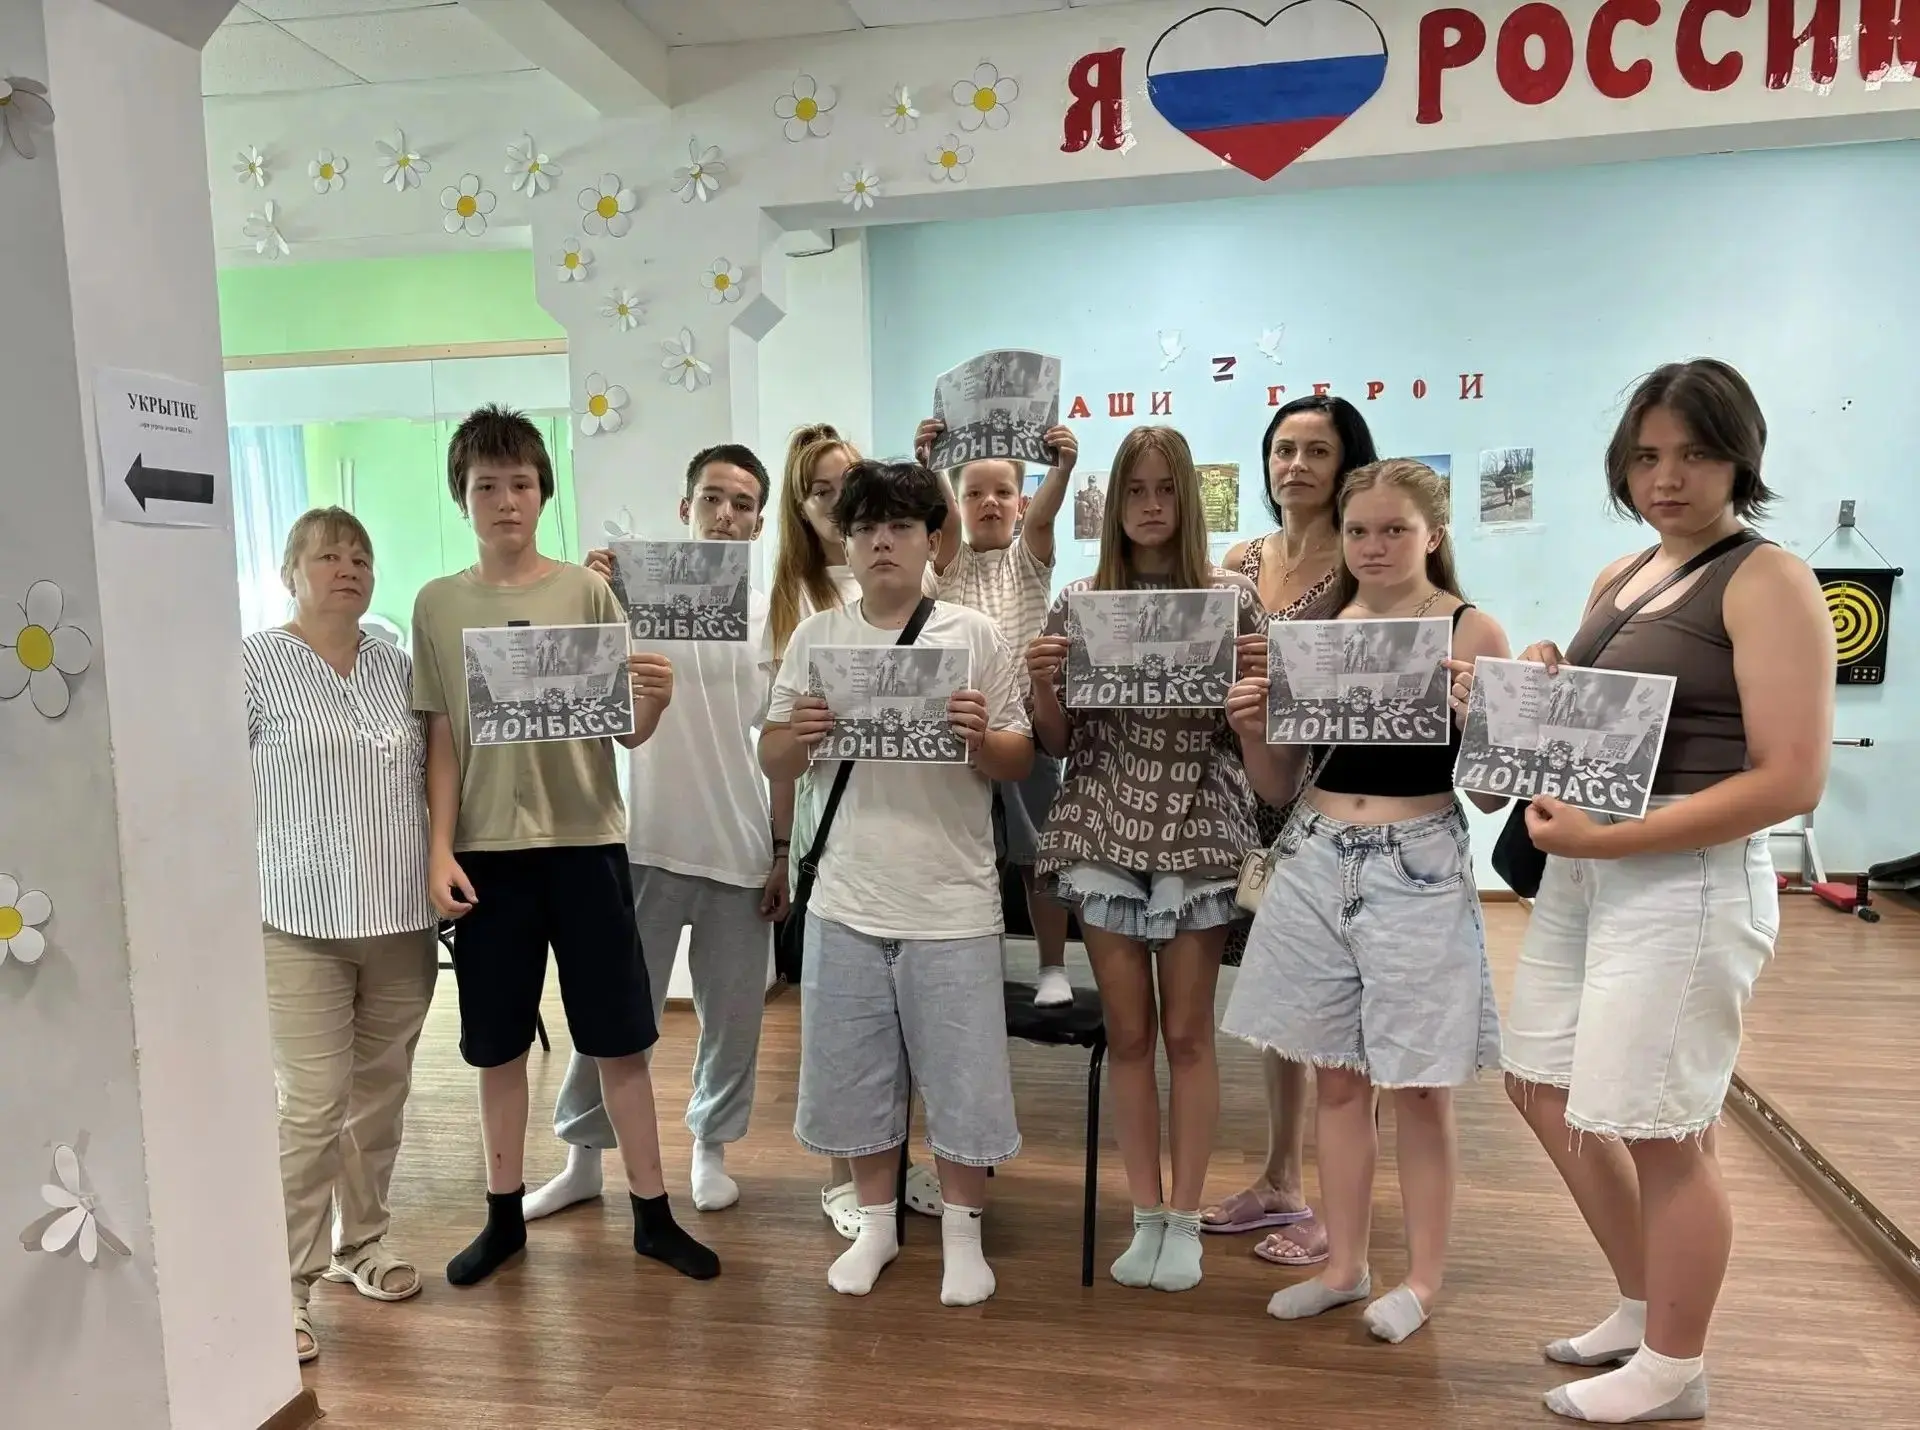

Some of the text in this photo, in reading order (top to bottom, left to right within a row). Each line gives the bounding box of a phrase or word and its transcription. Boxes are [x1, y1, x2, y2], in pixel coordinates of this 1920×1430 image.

[1060, 46, 1127, 153] Я
[128, 392, 199, 420] УКРЫТИЕ
[1067, 373, 1484, 418] АШИ ГЕРОИ
[932, 435, 1053, 470] ДОНБАСС
[635, 619, 740, 639] ОНБАСС
[1071, 681, 1223, 705] ДОНБАСС
[476, 711, 624, 742] ДОНБАСС
[1271, 716, 1436, 741] ДОНБАСС
[813, 735, 957, 758] ДОНБАСС
[1118, 740, 1163, 782] GOOD
[1458, 763, 1632, 809] ДОНБАСС
[1165, 792, 1194, 815] SE
[1105, 798, 1155, 842] GOOD
[1156, 848, 1198, 872] SEE
